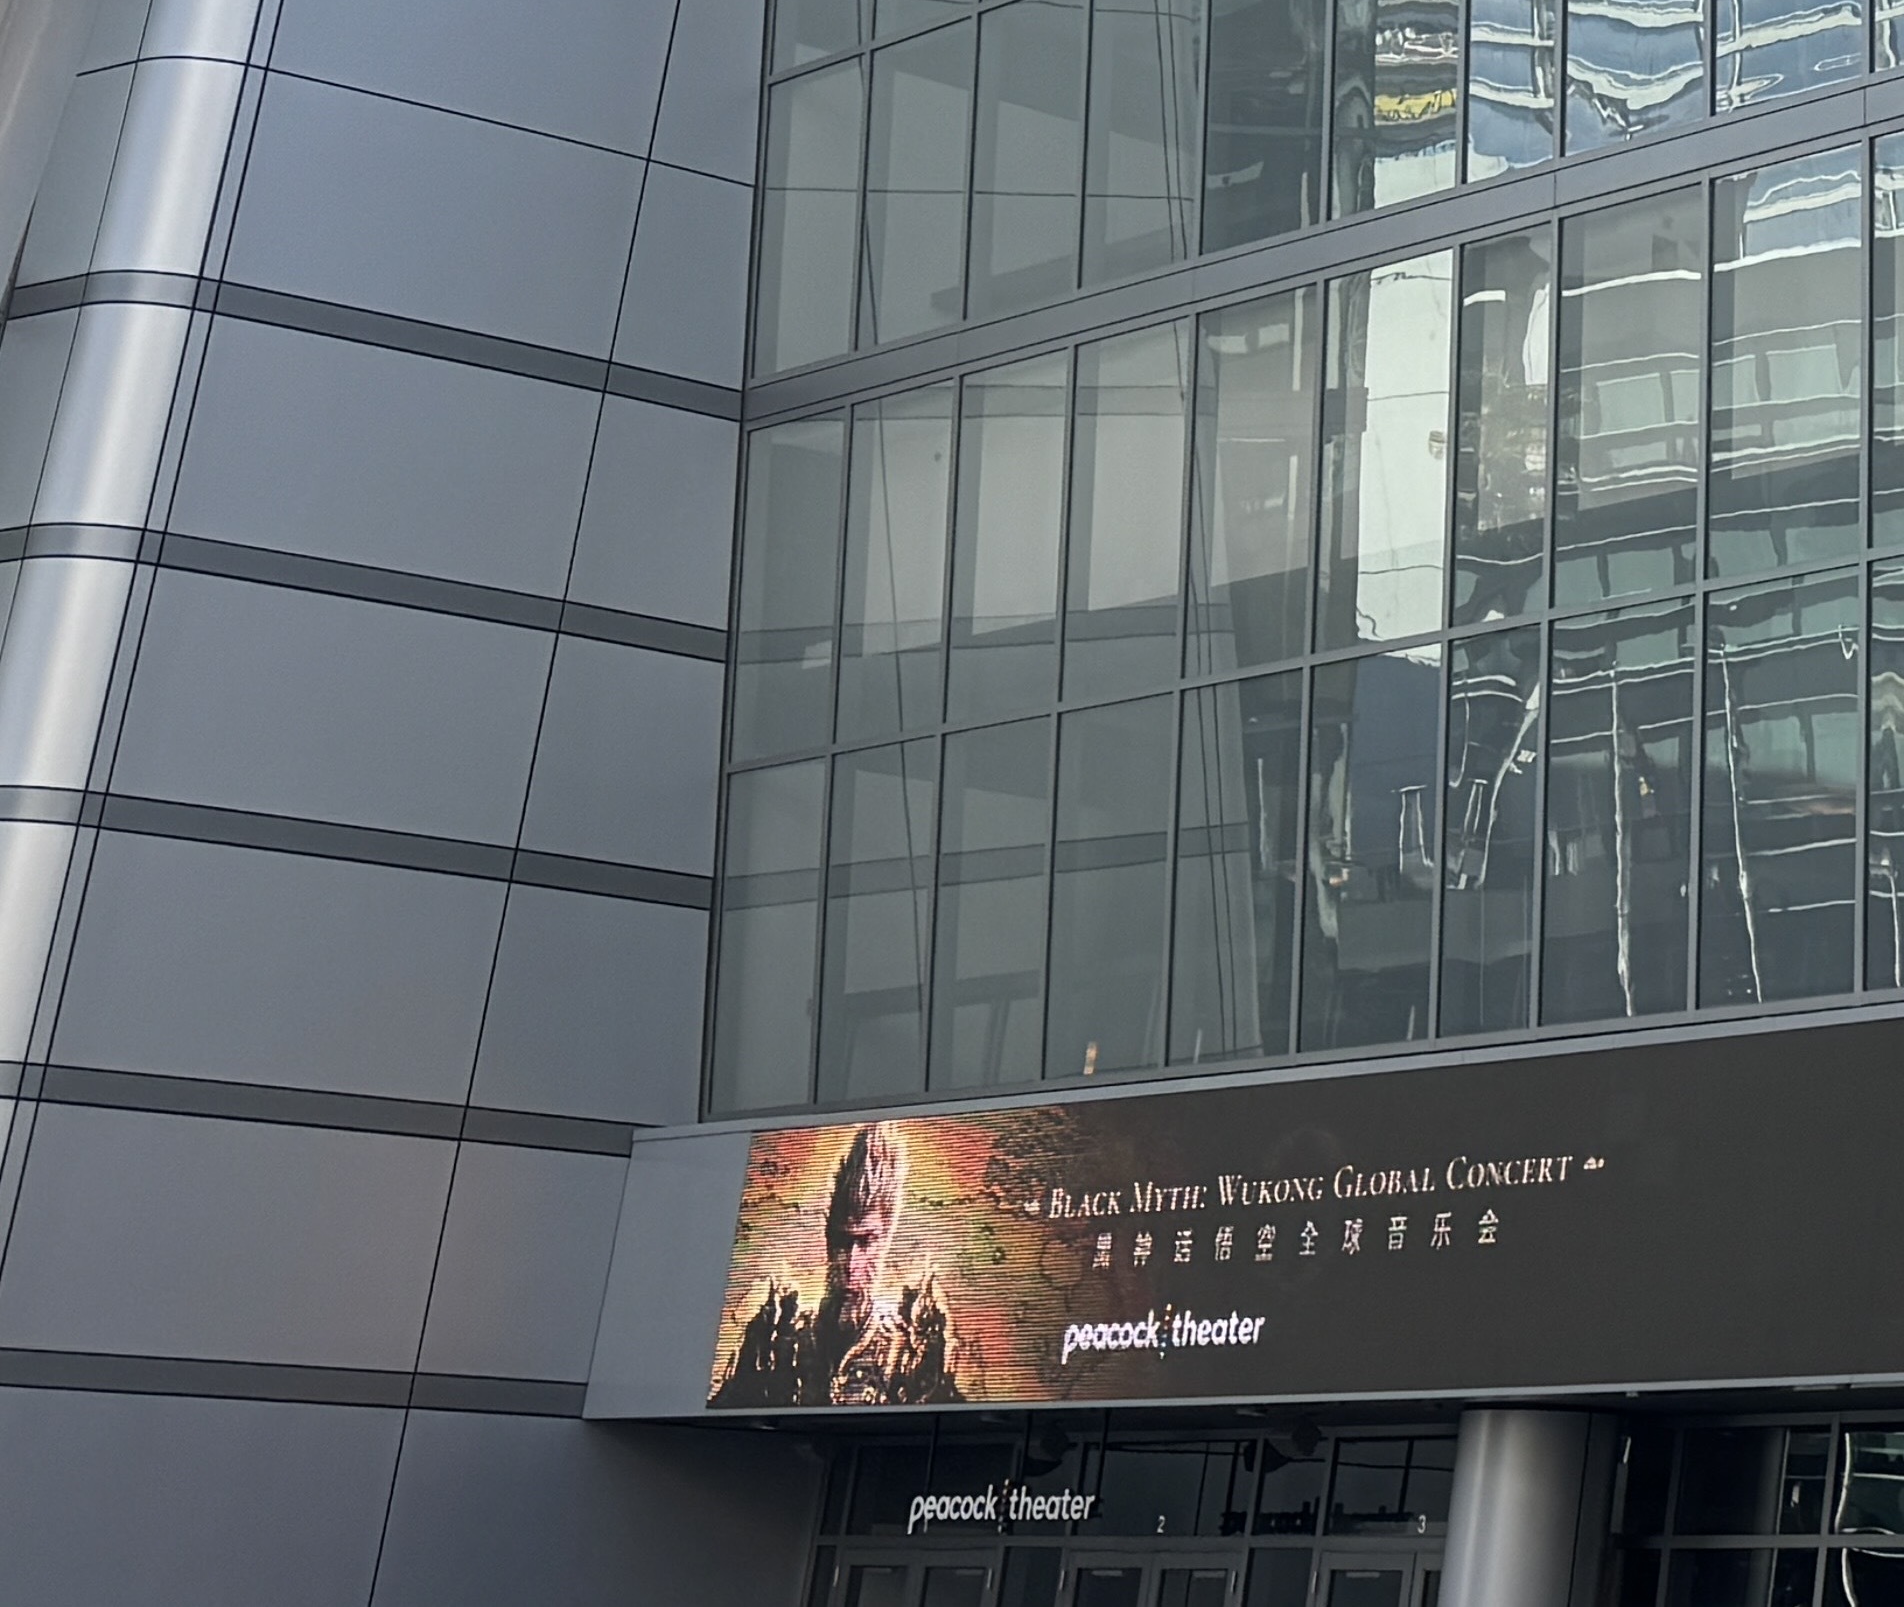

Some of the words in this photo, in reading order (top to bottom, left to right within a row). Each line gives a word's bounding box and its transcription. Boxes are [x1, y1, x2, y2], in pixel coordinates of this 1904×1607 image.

[1061, 1308, 1160, 1363] peacock
[1171, 1309, 1266, 1345] theater
[906, 1484, 998, 1535] peacock
[1007, 1485, 1096, 1521] theater
[1156, 1515, 1166, 1533] 2
[1417, 1514, 1427, 1533] 3
